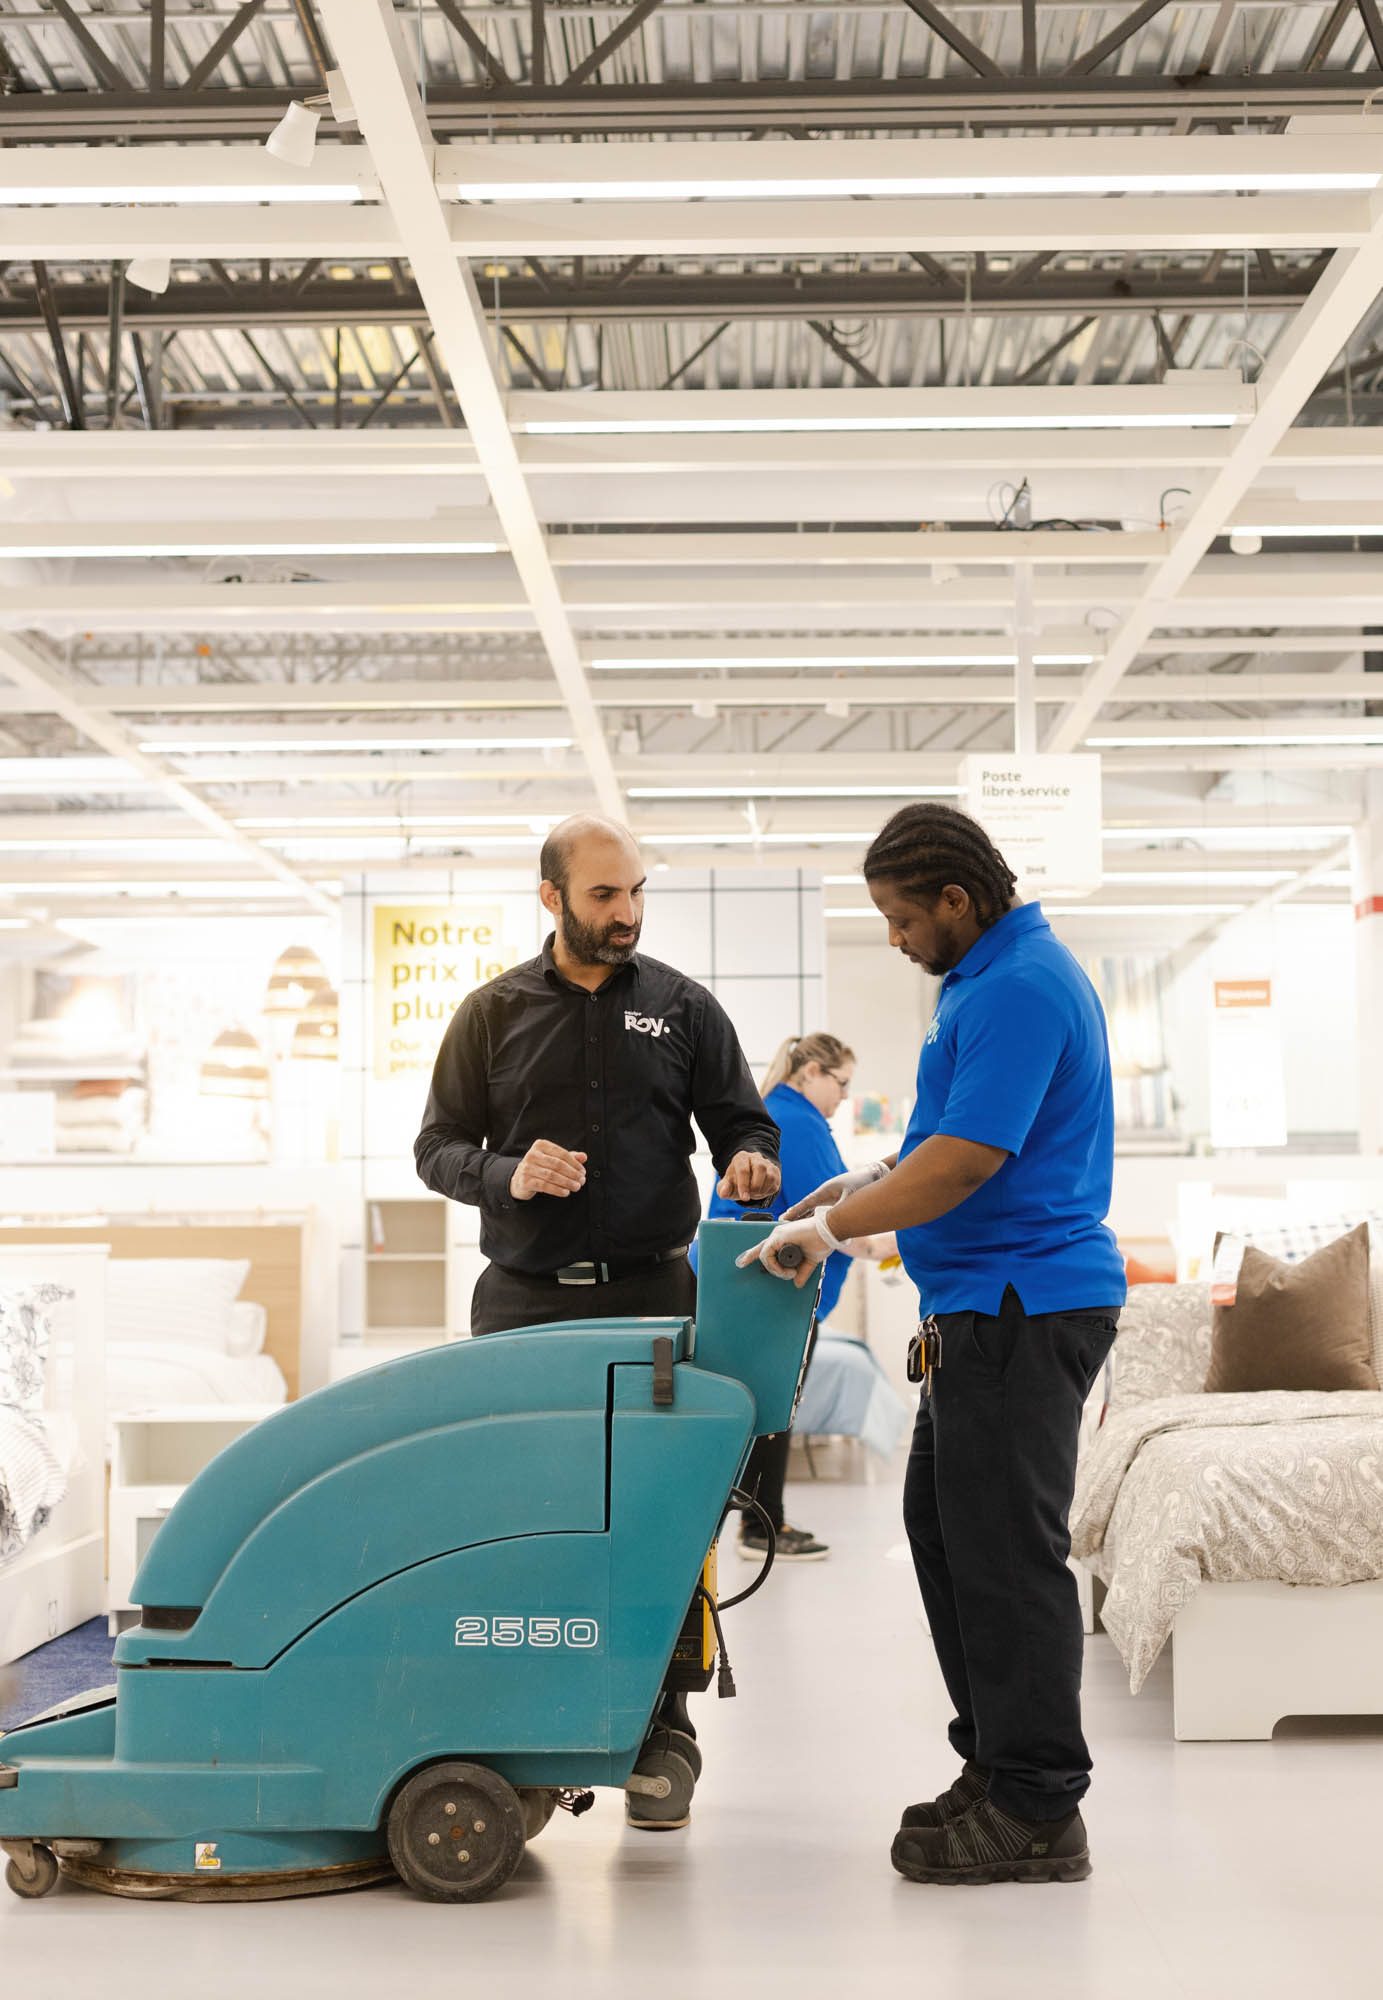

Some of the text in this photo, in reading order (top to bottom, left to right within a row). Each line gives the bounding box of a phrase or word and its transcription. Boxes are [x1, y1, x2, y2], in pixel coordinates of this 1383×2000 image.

[982, 770, 1022, 782] Poste
[982, 786, 1071, 797] libre-service
[392, 920, 493, 946] Notre
[392, 957, 458, 989] prix
[455, 1616, 599, 1648] 2550
